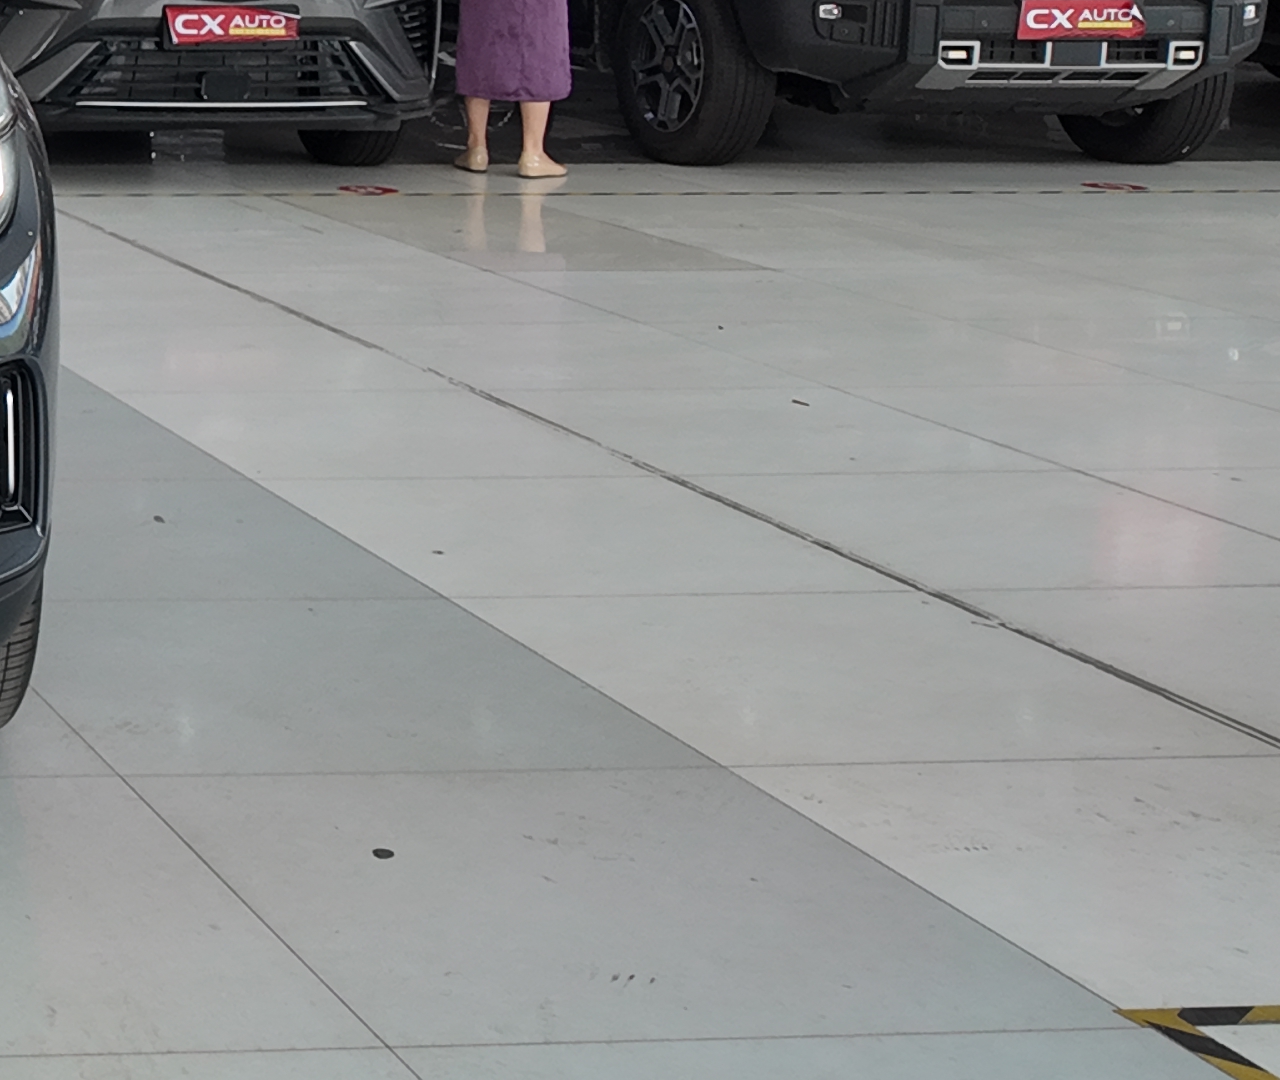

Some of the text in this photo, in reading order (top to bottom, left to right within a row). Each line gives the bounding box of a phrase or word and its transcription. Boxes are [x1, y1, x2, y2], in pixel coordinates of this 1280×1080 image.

[174, 14, 287, 35] CX AUTO
[1025, 8, 1134, 29] CX AUTO
